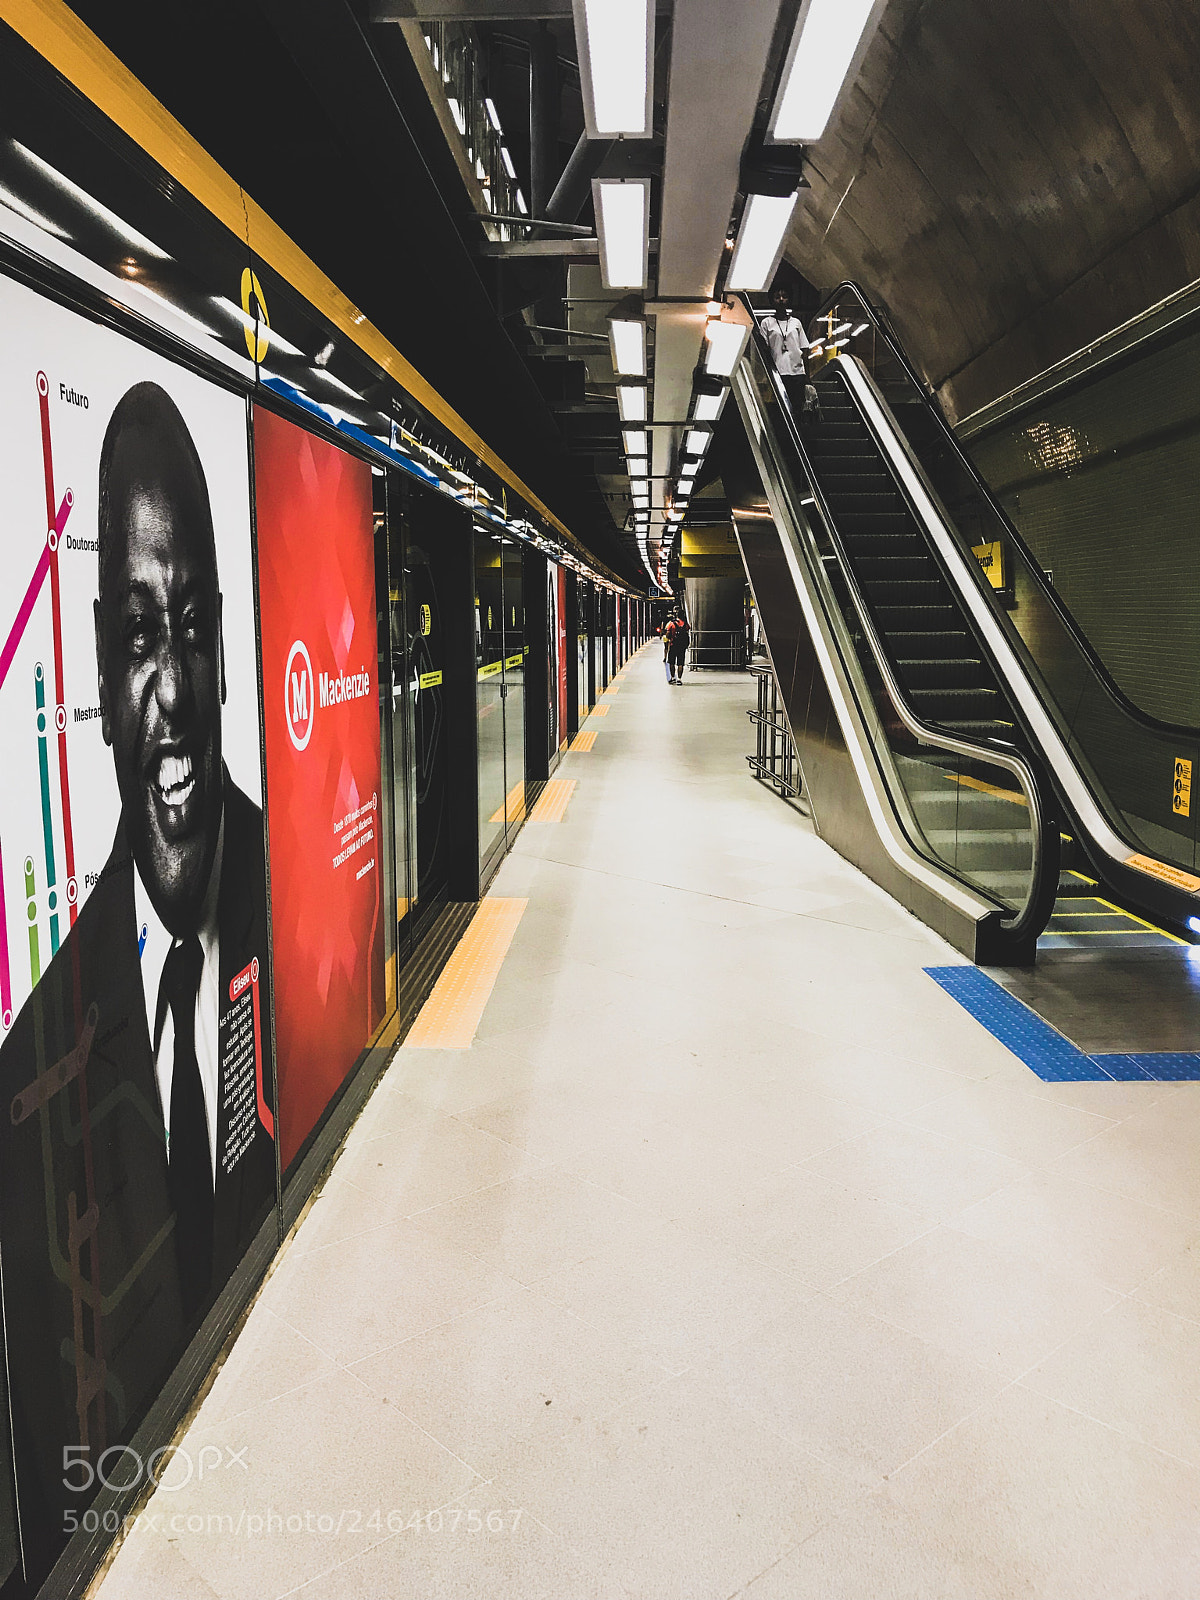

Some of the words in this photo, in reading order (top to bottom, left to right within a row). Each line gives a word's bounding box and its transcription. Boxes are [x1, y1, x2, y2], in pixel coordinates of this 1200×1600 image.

[59, 382, 89, 410] Futuro
[319, 664, 370, 709] Mackenzie
[234, 972, 249, 995] Eliseu
